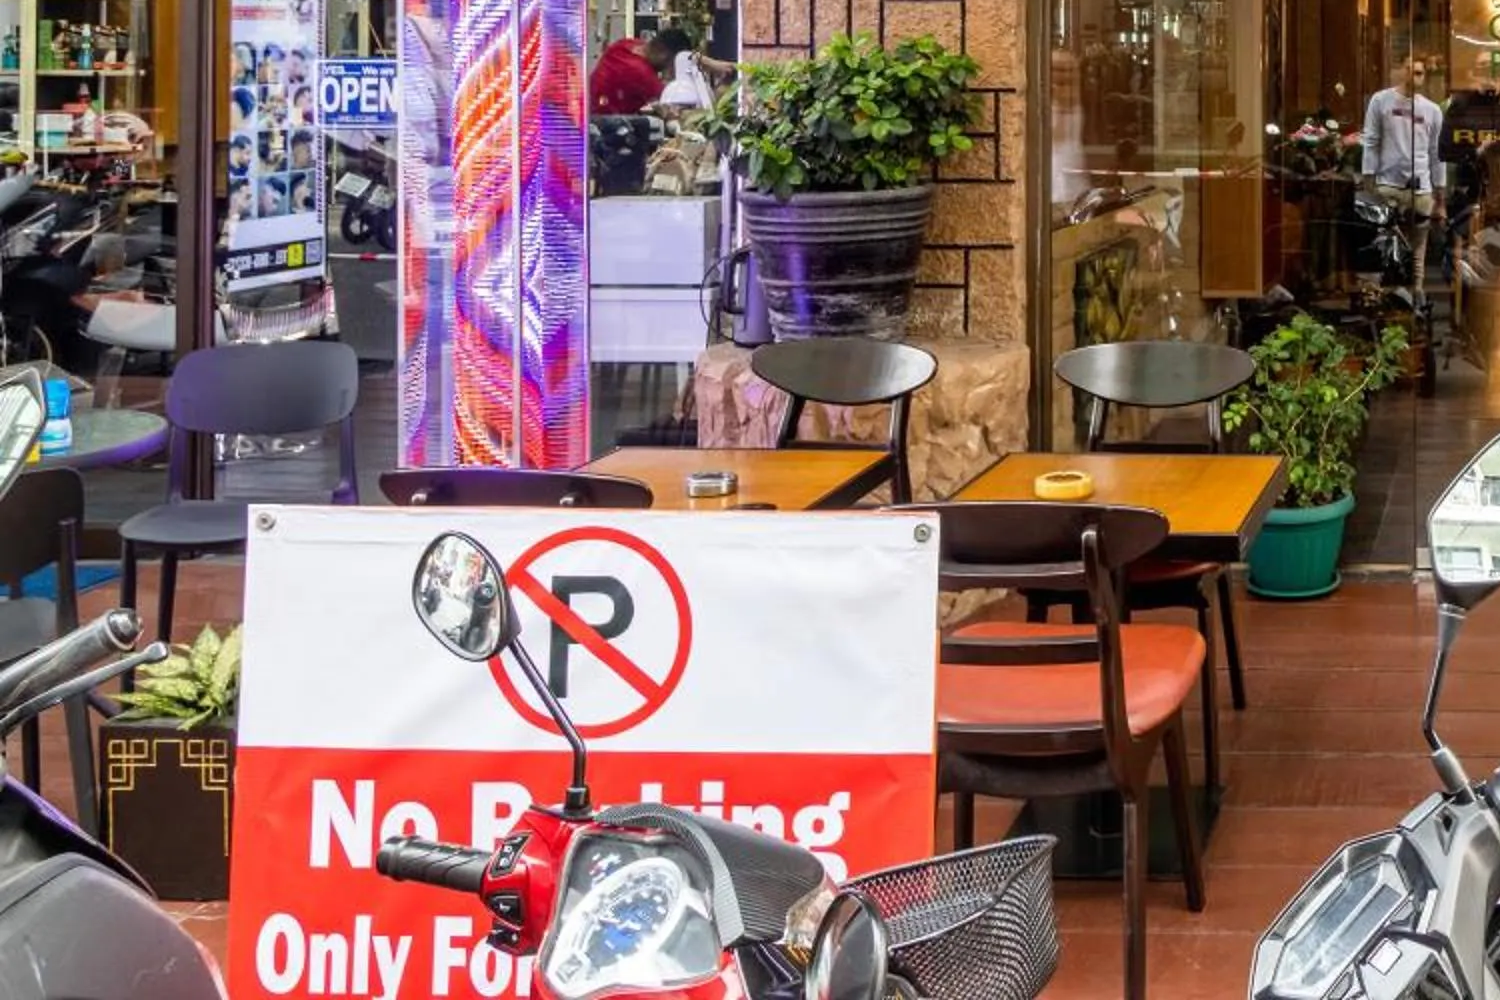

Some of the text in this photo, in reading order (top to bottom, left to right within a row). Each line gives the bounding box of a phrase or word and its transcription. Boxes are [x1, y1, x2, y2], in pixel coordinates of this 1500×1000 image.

[320, 76, 398, 113] OPEN
[309, 778, 439, 868] No
[255, 912, 412, 1000] Only
